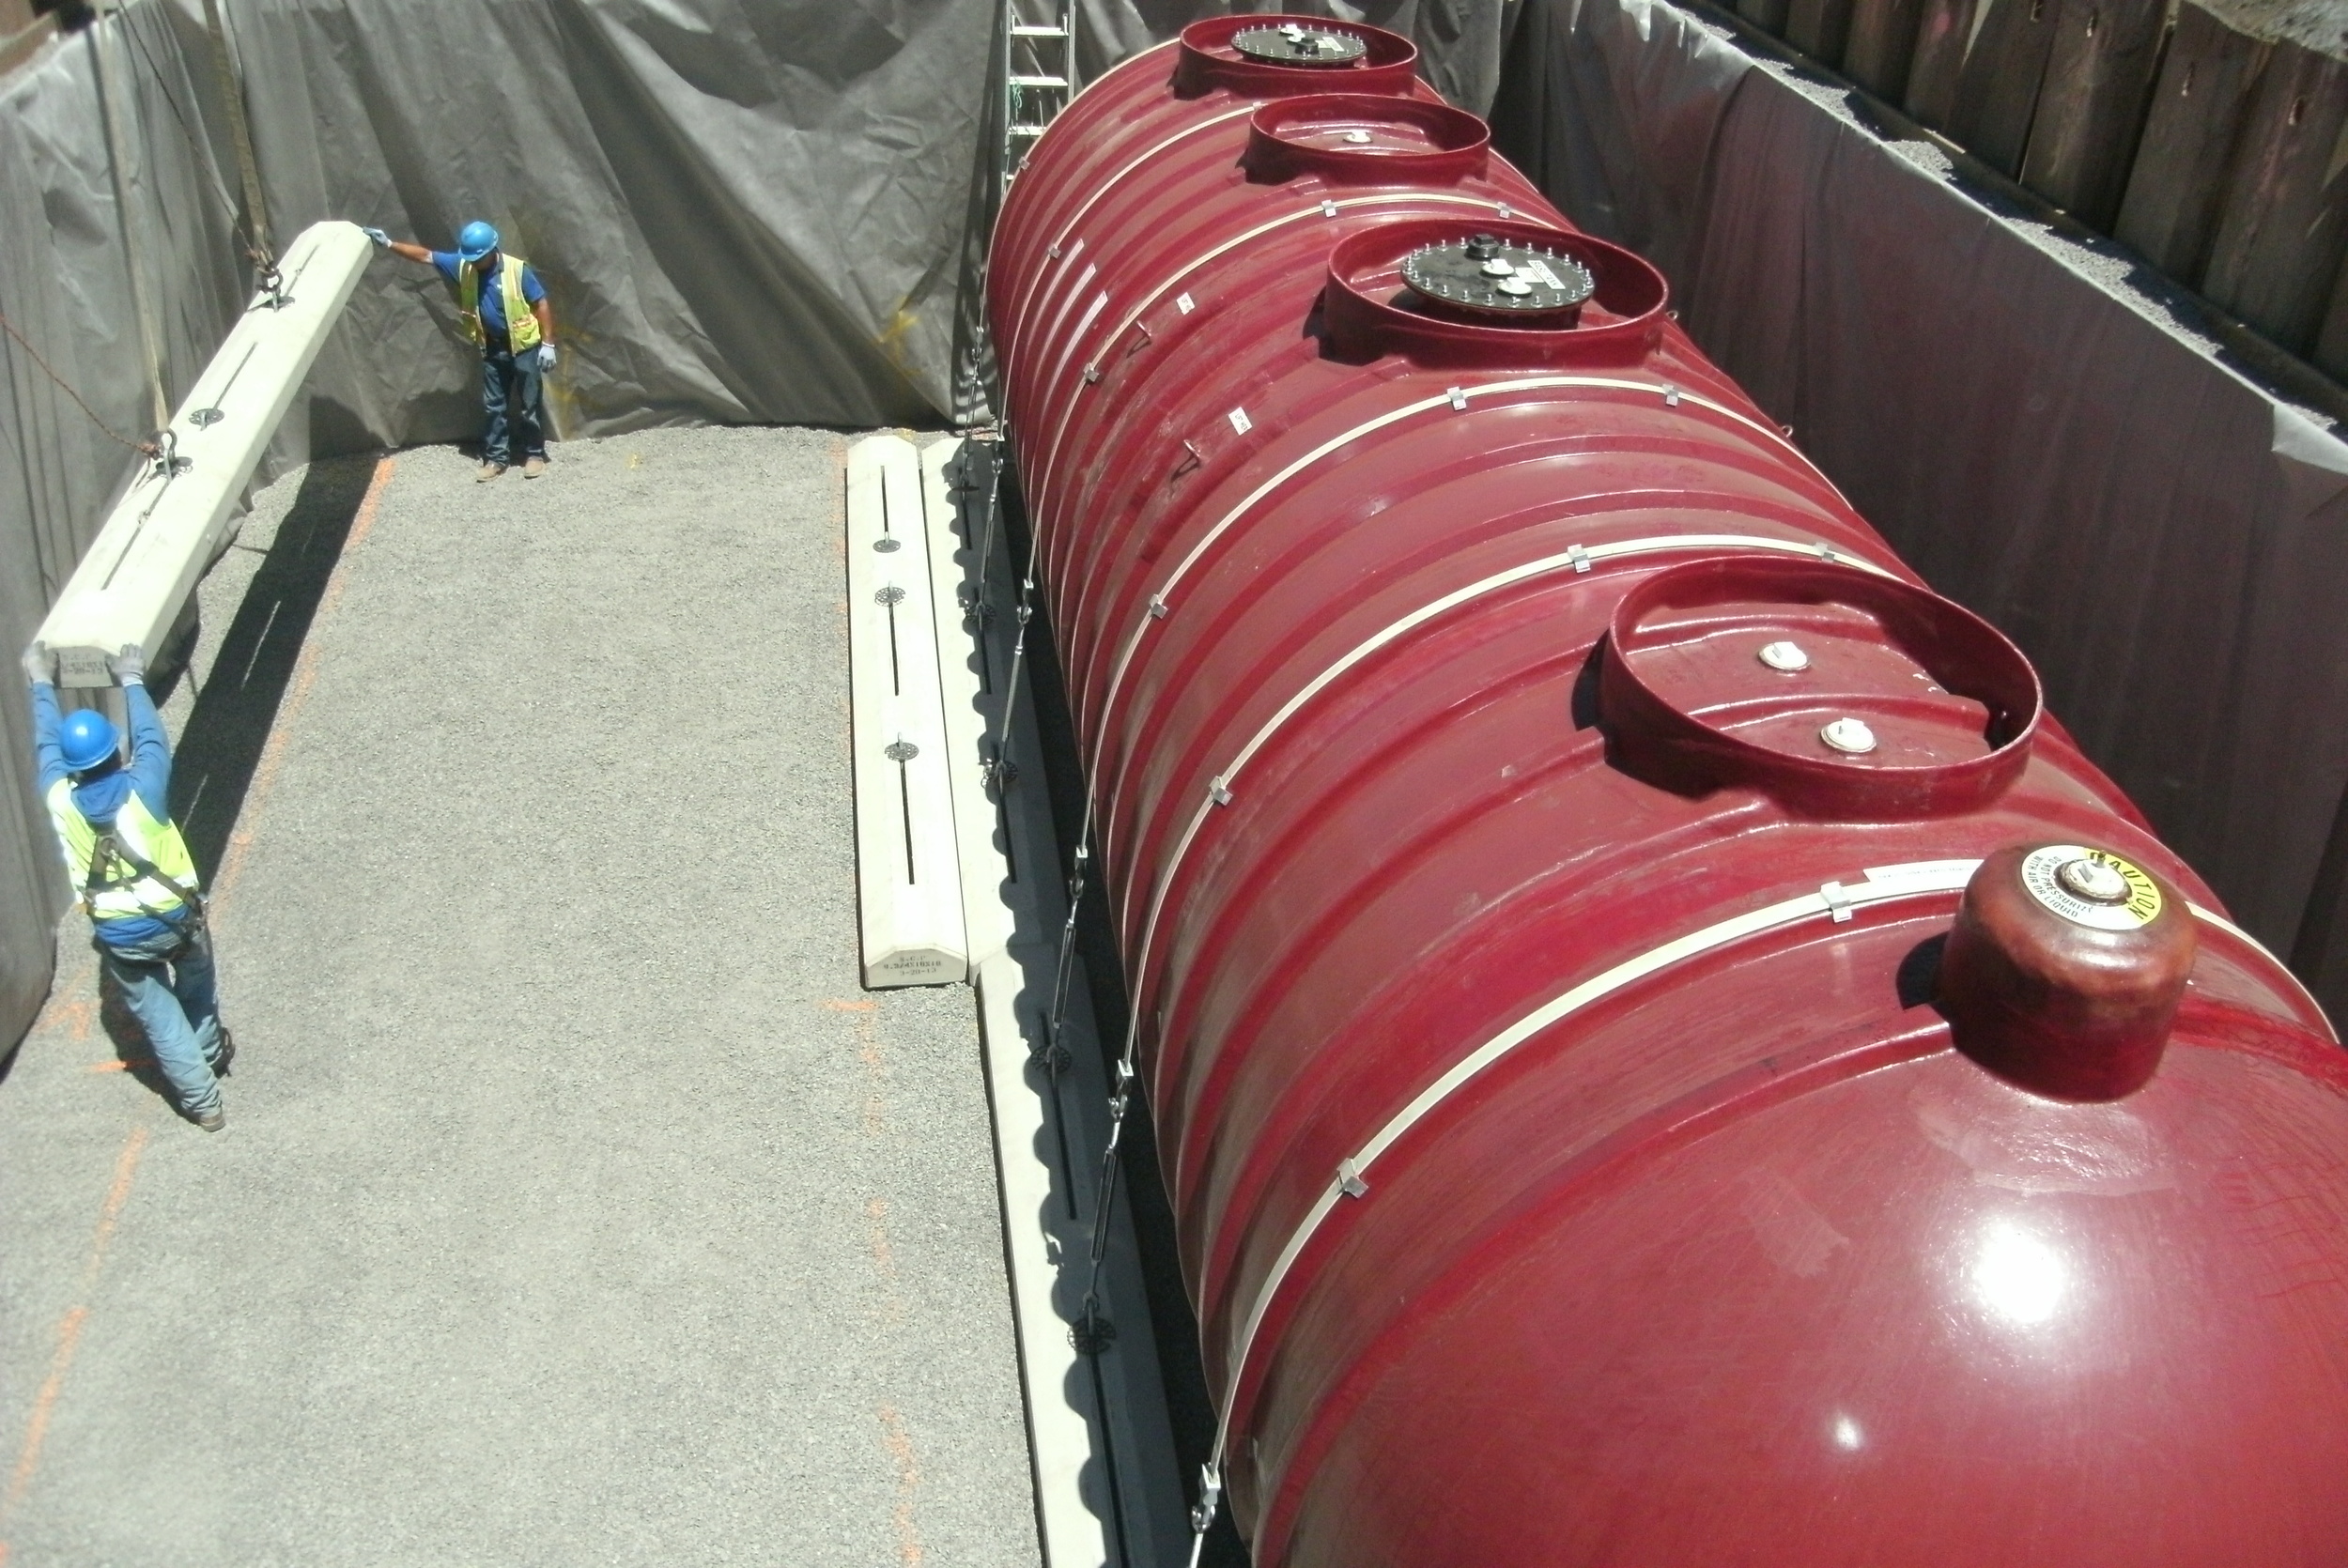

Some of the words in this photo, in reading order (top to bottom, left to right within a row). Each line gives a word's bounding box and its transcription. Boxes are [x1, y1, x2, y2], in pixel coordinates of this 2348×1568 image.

[2027, 855, 2044, 870] WITH
[2047, 855, 2062, 865] DO
[2040, 863, 2053, 875] NOT
[2028, 871, 2039, 883] AIR
[2032, 884, 2047, 895] OR
[2089, 852, 2156, 921] CAUTION
[2044, 896, 2078, 917] LIQUID
